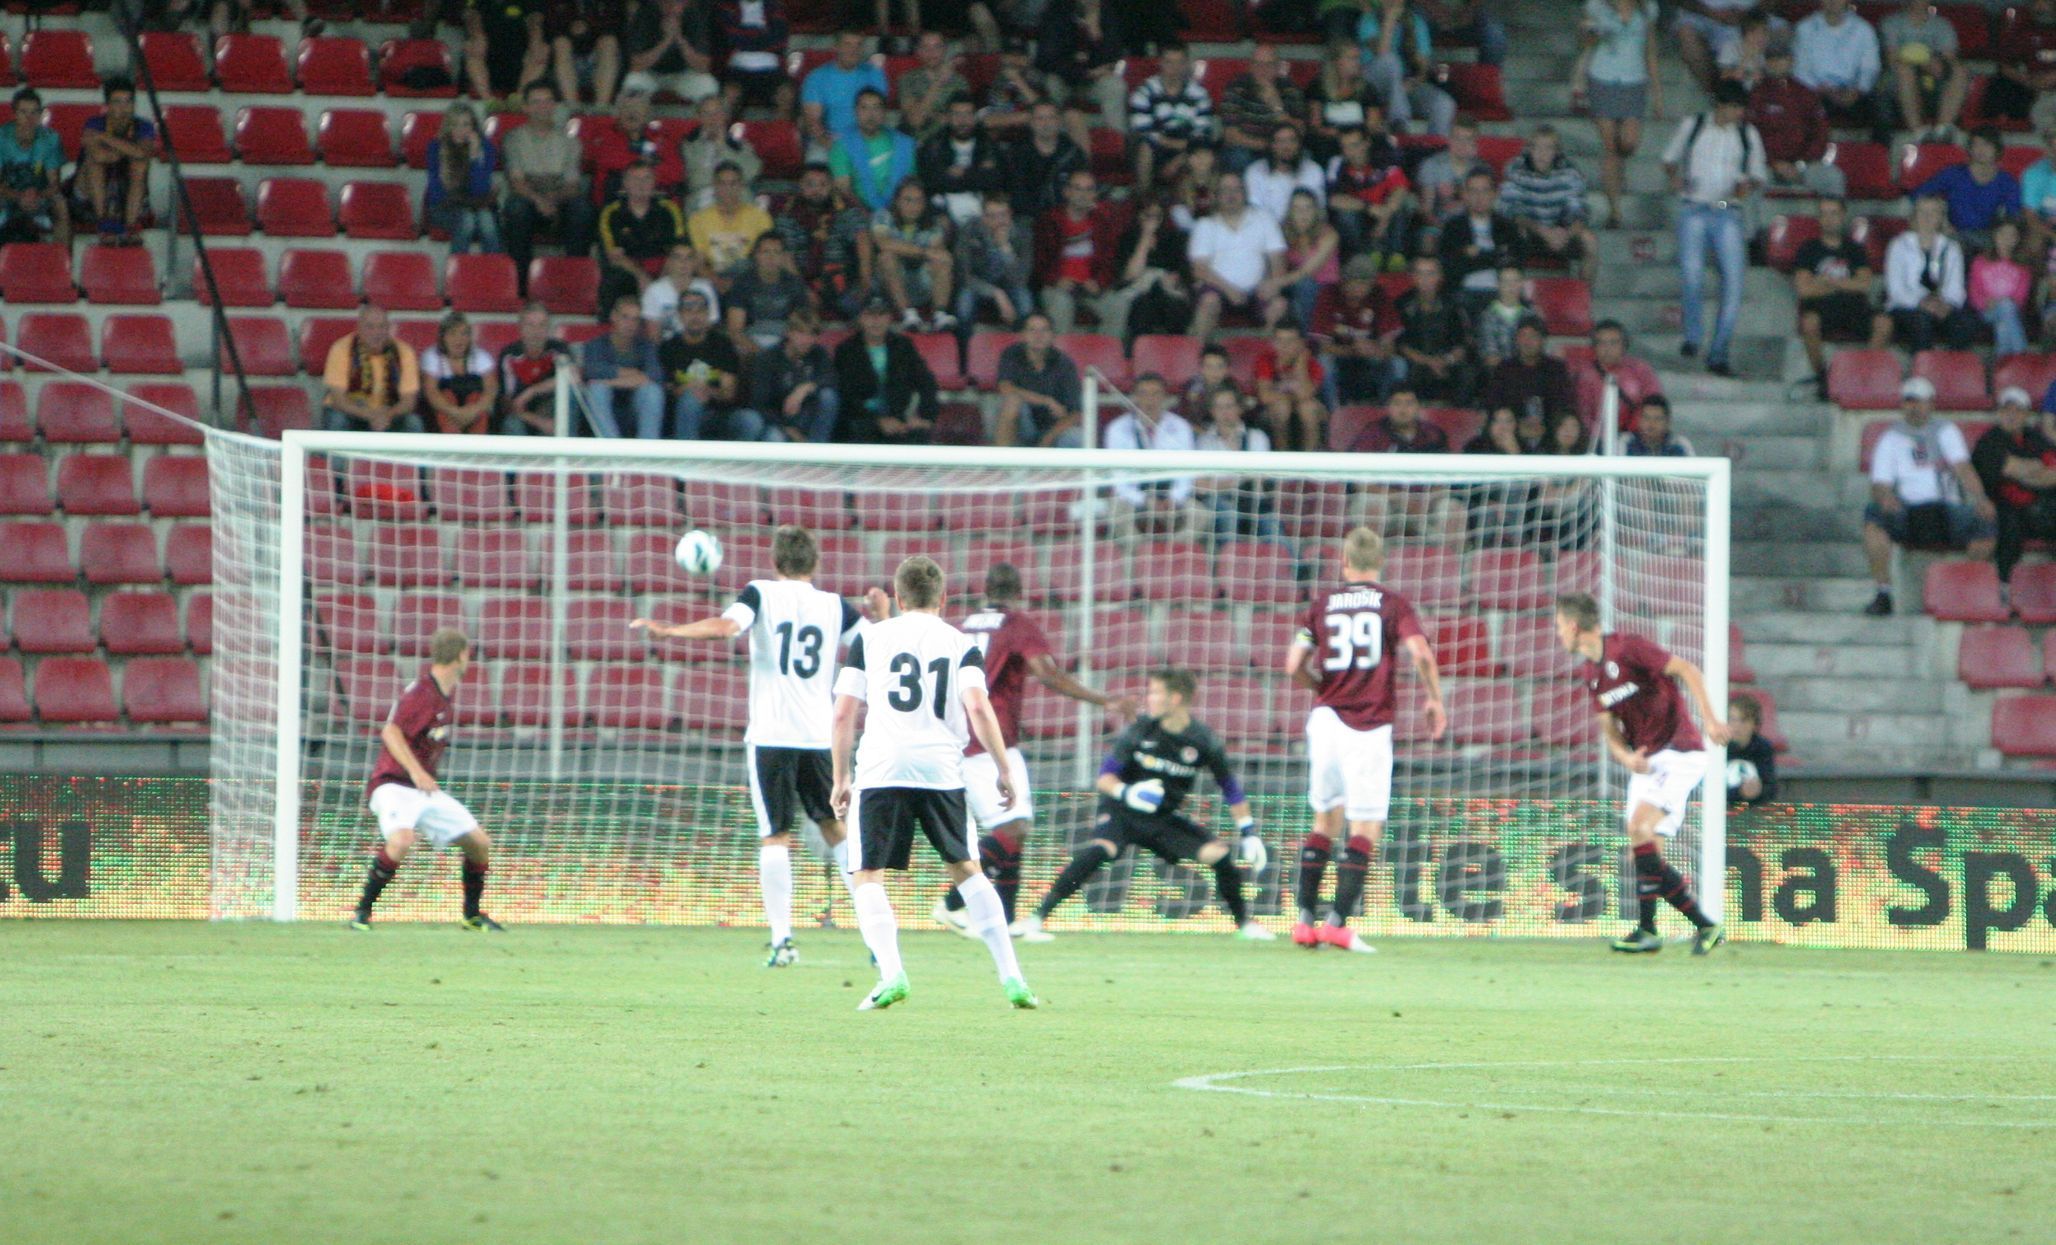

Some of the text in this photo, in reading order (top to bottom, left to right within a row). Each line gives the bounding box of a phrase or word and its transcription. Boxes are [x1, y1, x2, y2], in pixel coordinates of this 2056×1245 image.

[775, 621, 823, 680] 13
[1324, 611, 1383, 671] 39
[887, 651, 951, 720] 31
[0, 820, 92, 904] u
[1886, 824, 2056, 950] Sp
